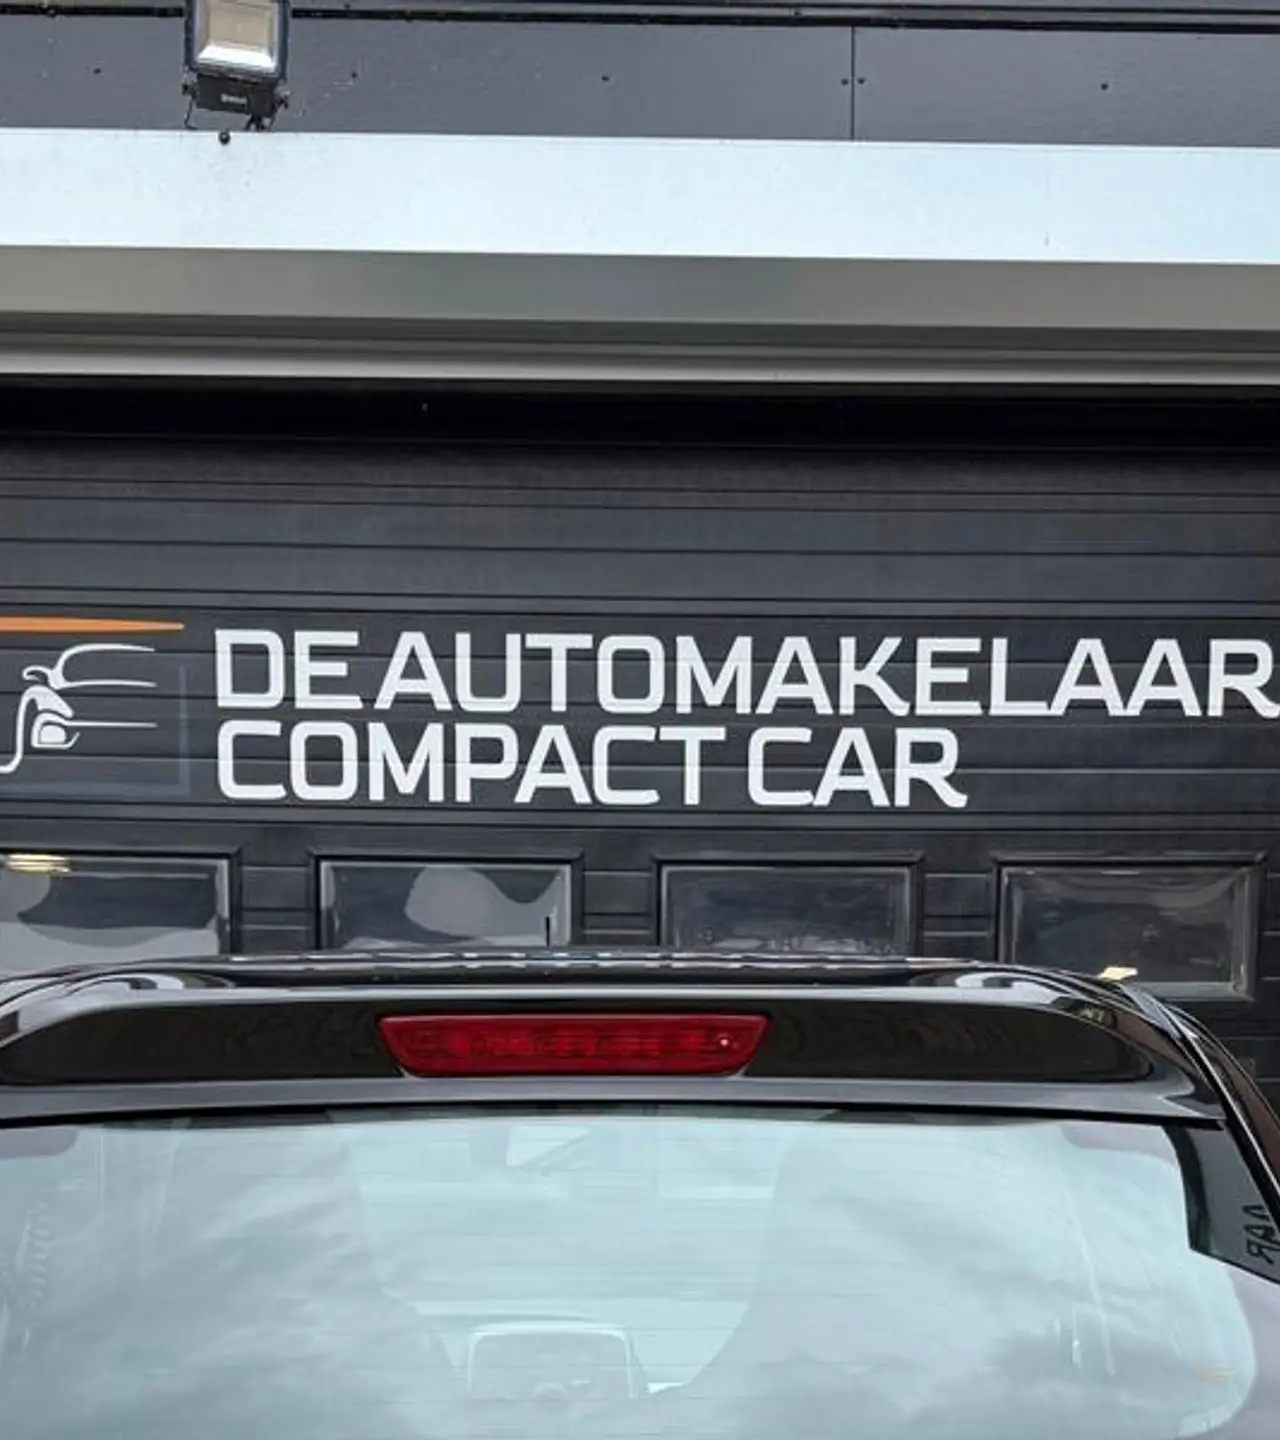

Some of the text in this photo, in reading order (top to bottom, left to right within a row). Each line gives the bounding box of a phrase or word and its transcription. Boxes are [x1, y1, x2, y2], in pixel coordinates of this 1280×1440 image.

[214, 628, 361, 712] DE
[217, 718, 968, 808] COMPACT CAR
